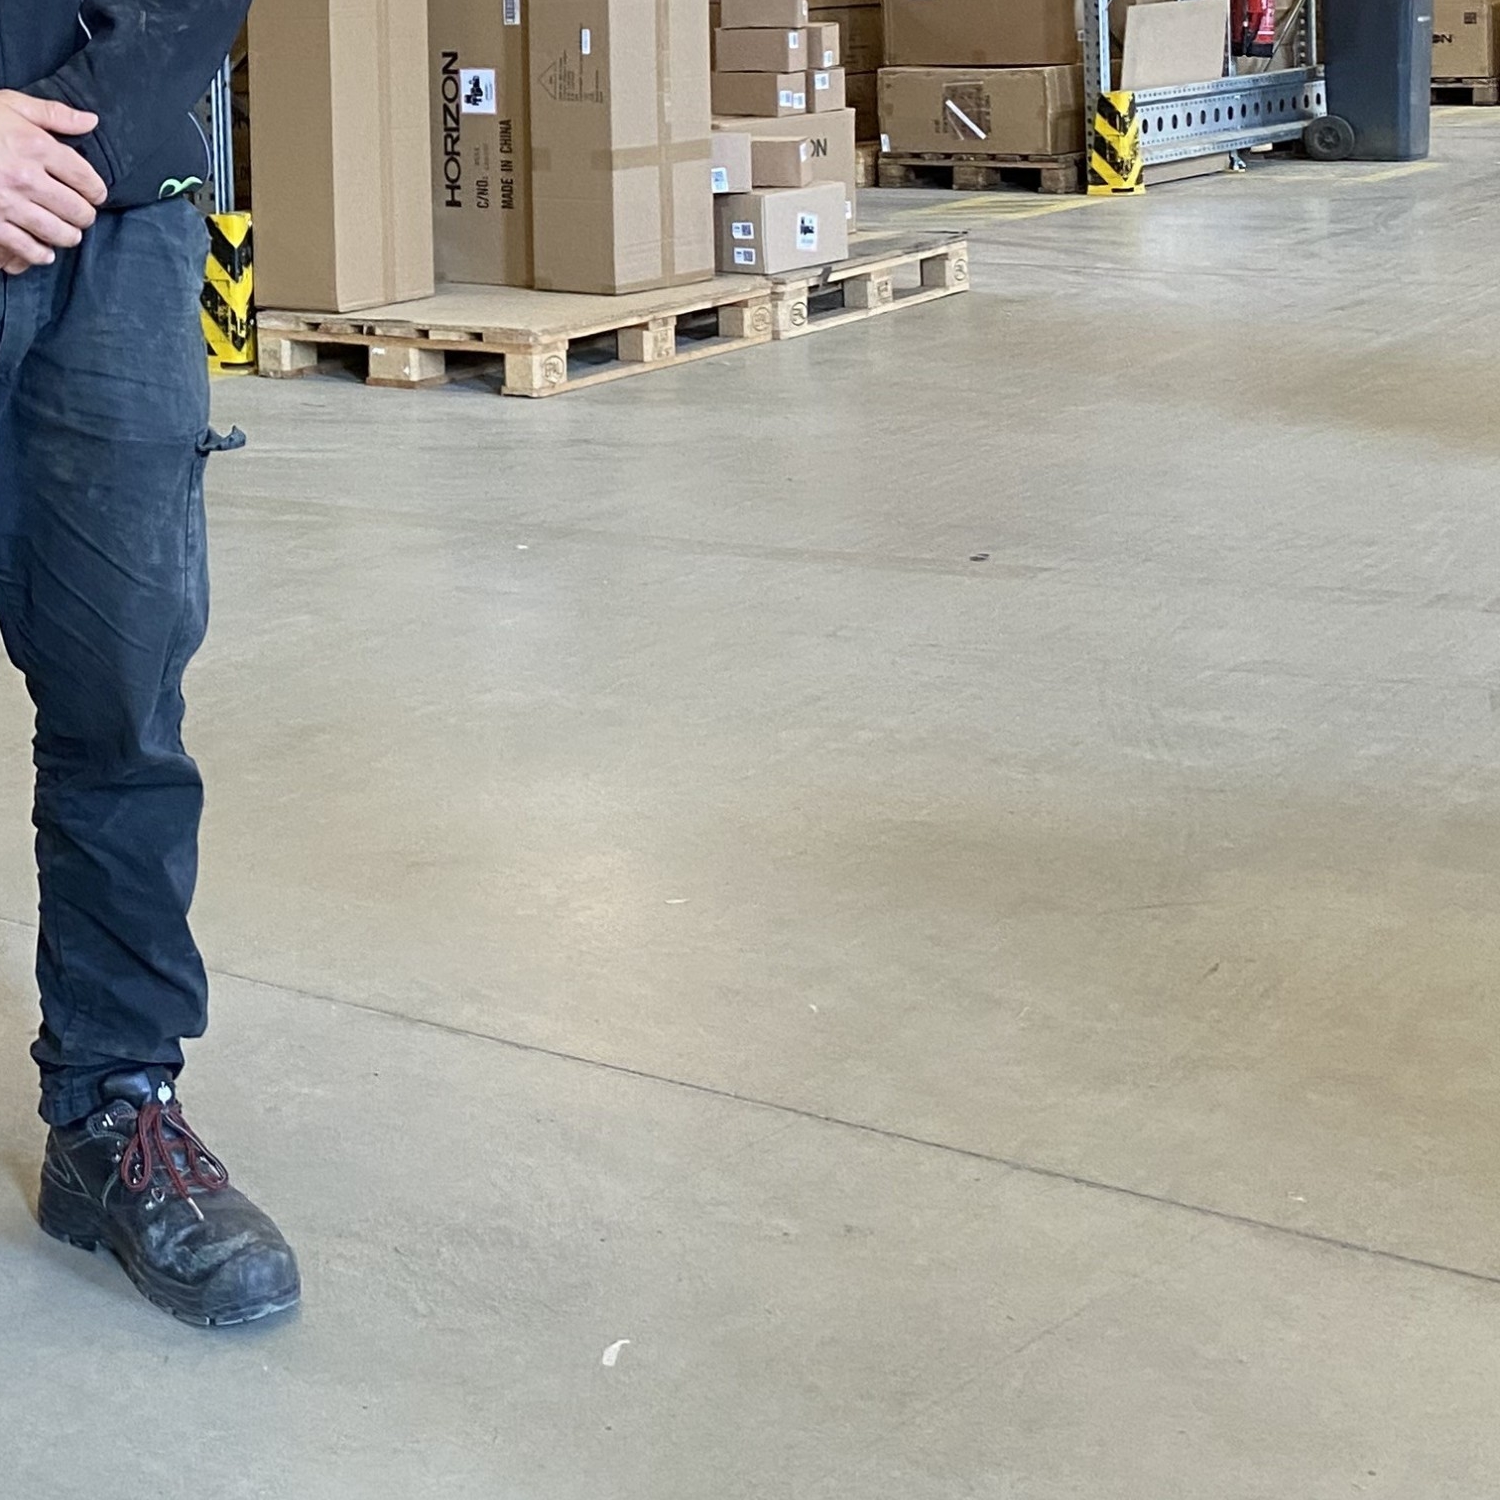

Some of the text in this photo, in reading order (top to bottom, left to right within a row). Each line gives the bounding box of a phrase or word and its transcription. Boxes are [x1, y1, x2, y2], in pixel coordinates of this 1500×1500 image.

[441, 51, 462, 208] HORIZON
[499, 119, 514, 209] MADE IN CHINA
